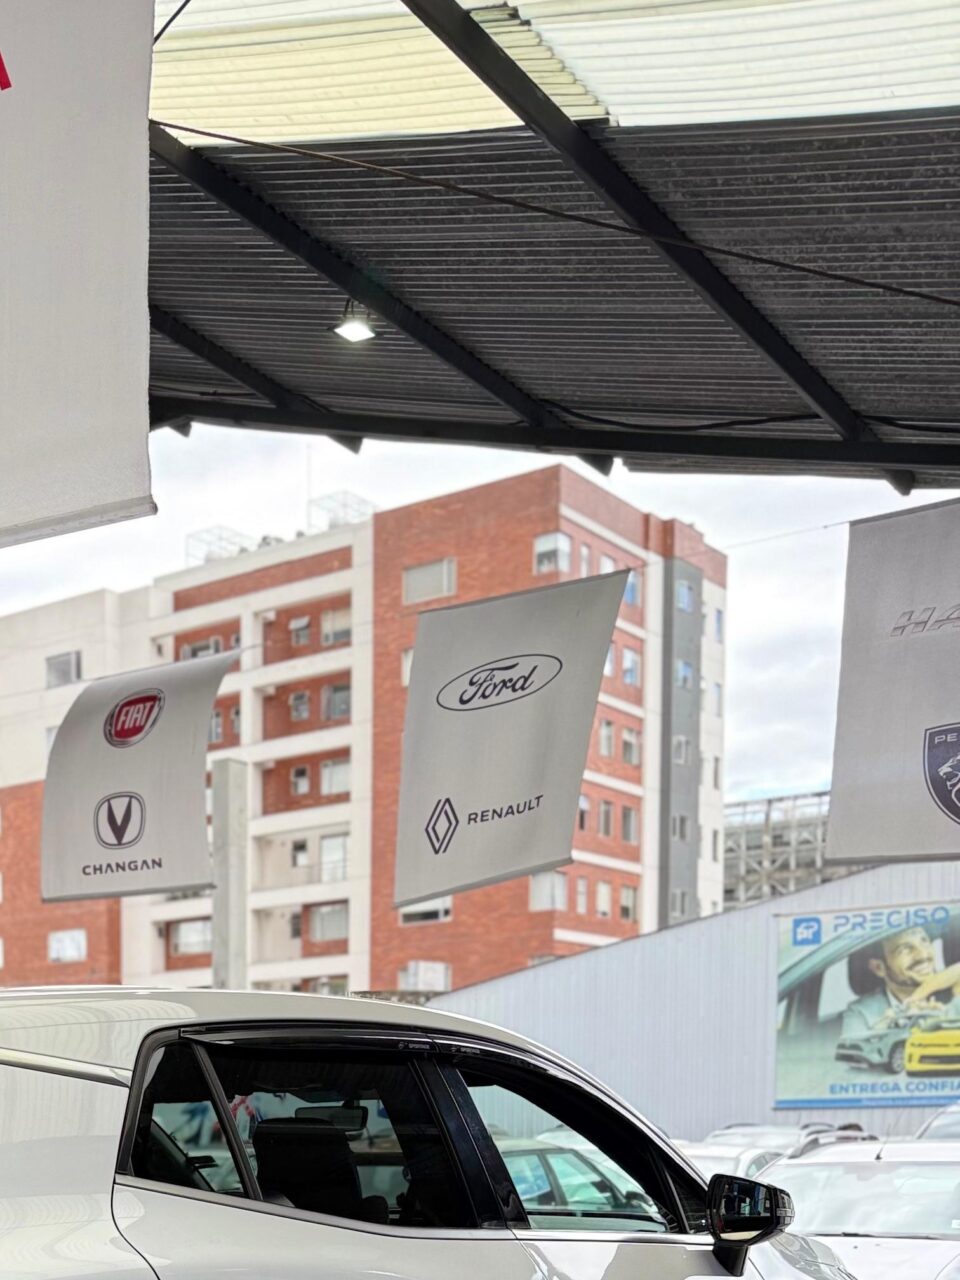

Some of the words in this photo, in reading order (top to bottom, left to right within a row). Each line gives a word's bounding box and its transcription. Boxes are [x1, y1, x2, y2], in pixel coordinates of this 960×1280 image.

[458, 662, 538, 705] Ford
[116, 701, 154, 731] FIAT
[467, 795, 544, 825] RENAULT
[82, 857, 163, 876] CHANGAN
[833, 906, 950, 933] PRECISO
[829, 1083, 902, 1095] ENTREGA
